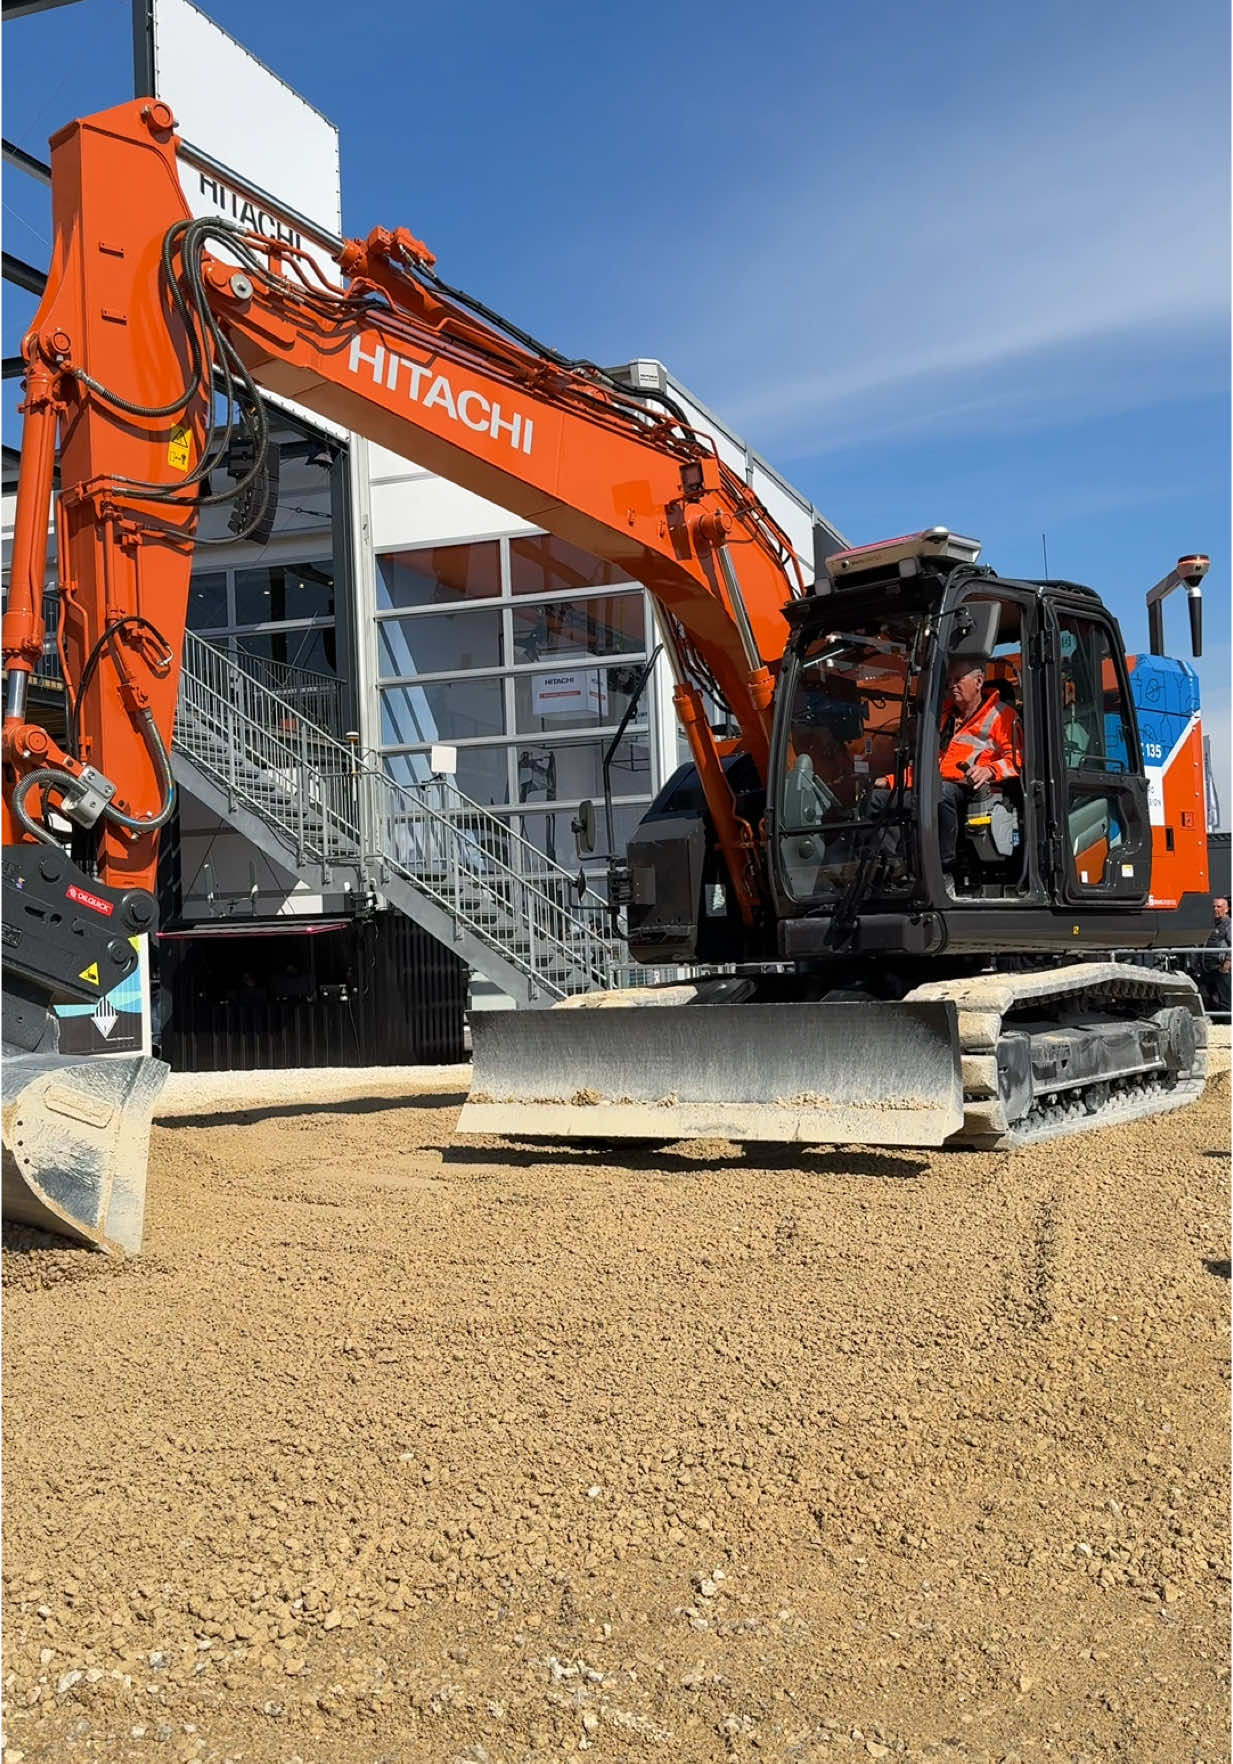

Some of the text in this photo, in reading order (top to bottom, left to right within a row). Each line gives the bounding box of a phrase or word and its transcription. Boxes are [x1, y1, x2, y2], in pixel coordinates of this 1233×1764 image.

[200, 172, 301, 261] HITACHI
[348, 334, 534, 455] HITACHI
[1145, 743, 1162, 759] 135
